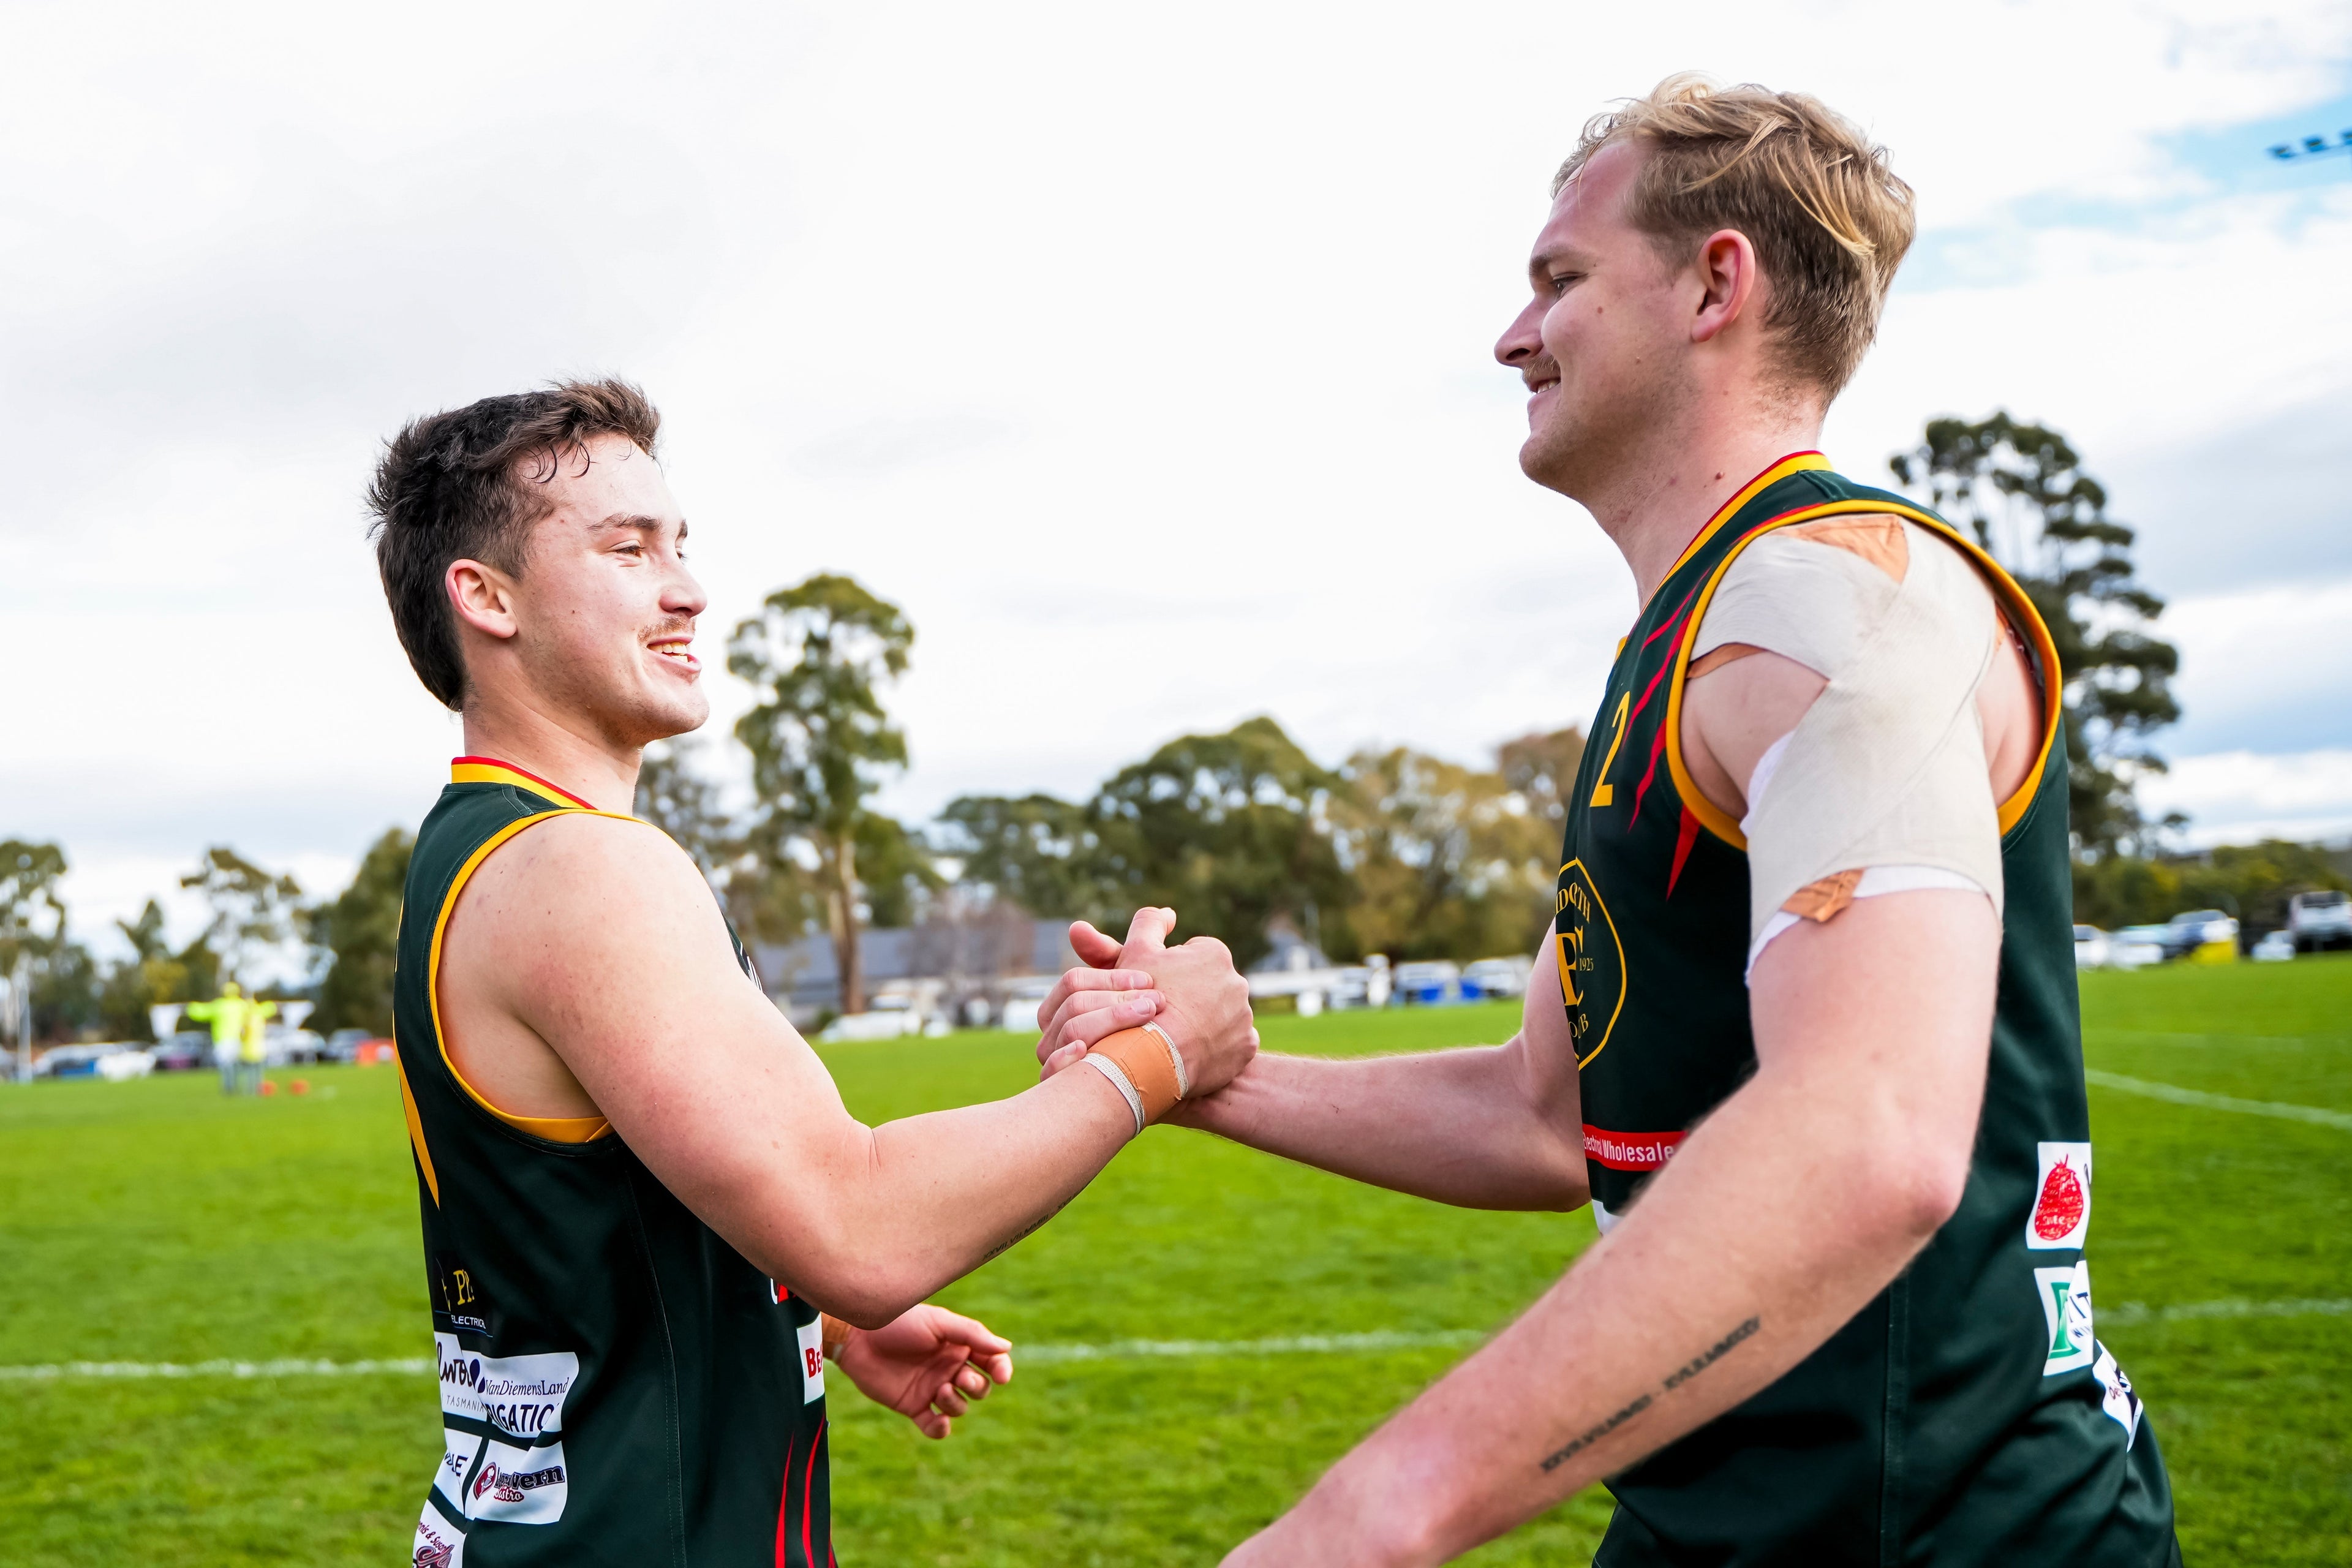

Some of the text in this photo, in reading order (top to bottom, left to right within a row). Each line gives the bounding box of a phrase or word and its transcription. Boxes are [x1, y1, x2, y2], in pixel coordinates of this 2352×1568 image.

[1589, 690, 1630, 807] 2
[1580, 957, 1594, 971] 1925
[805, 1344, 823, 1378] BE
[486, 1377, 569, 1395] VanDiemensLand
[447, 1395, 484, 1412] TASMANIA
[425, 1531, 436, 1540] &
